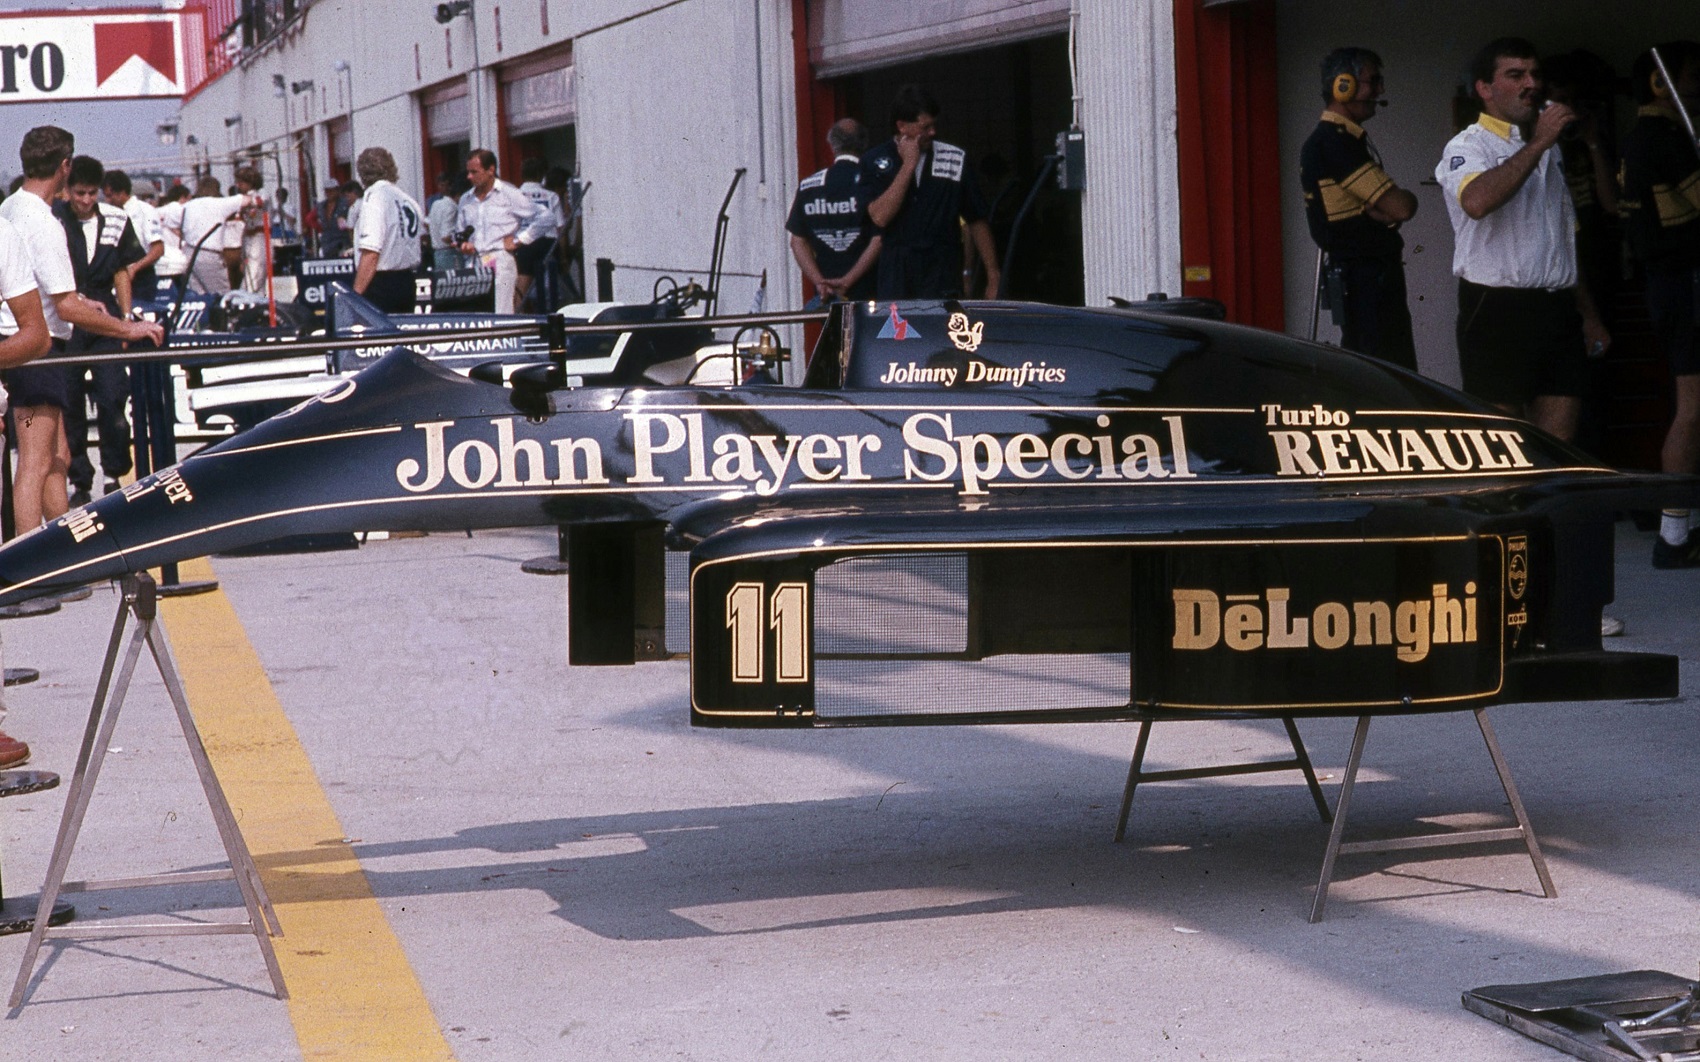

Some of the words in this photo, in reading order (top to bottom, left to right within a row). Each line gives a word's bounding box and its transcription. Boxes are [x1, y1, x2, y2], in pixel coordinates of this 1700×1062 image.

[302, 259, 354, 275] PIRELLI
[305, 285, 325, 303] el
[452, 337, 518, 353] ARMANI
[880, 361, 957, 387] Johnny
[965, 361, 1066, 388] Dumfries
[1261, 404, 1350, 427] Turbo
[396, 416, 610, 493] John
[623, 413, 882, 496] Player
[902, 412, 1197, 495] Special
[1268, 429, 1534, 476] RENAULT
[1508, 614, 1526, 624] KONI
[726, 582, 808, 683] 11
